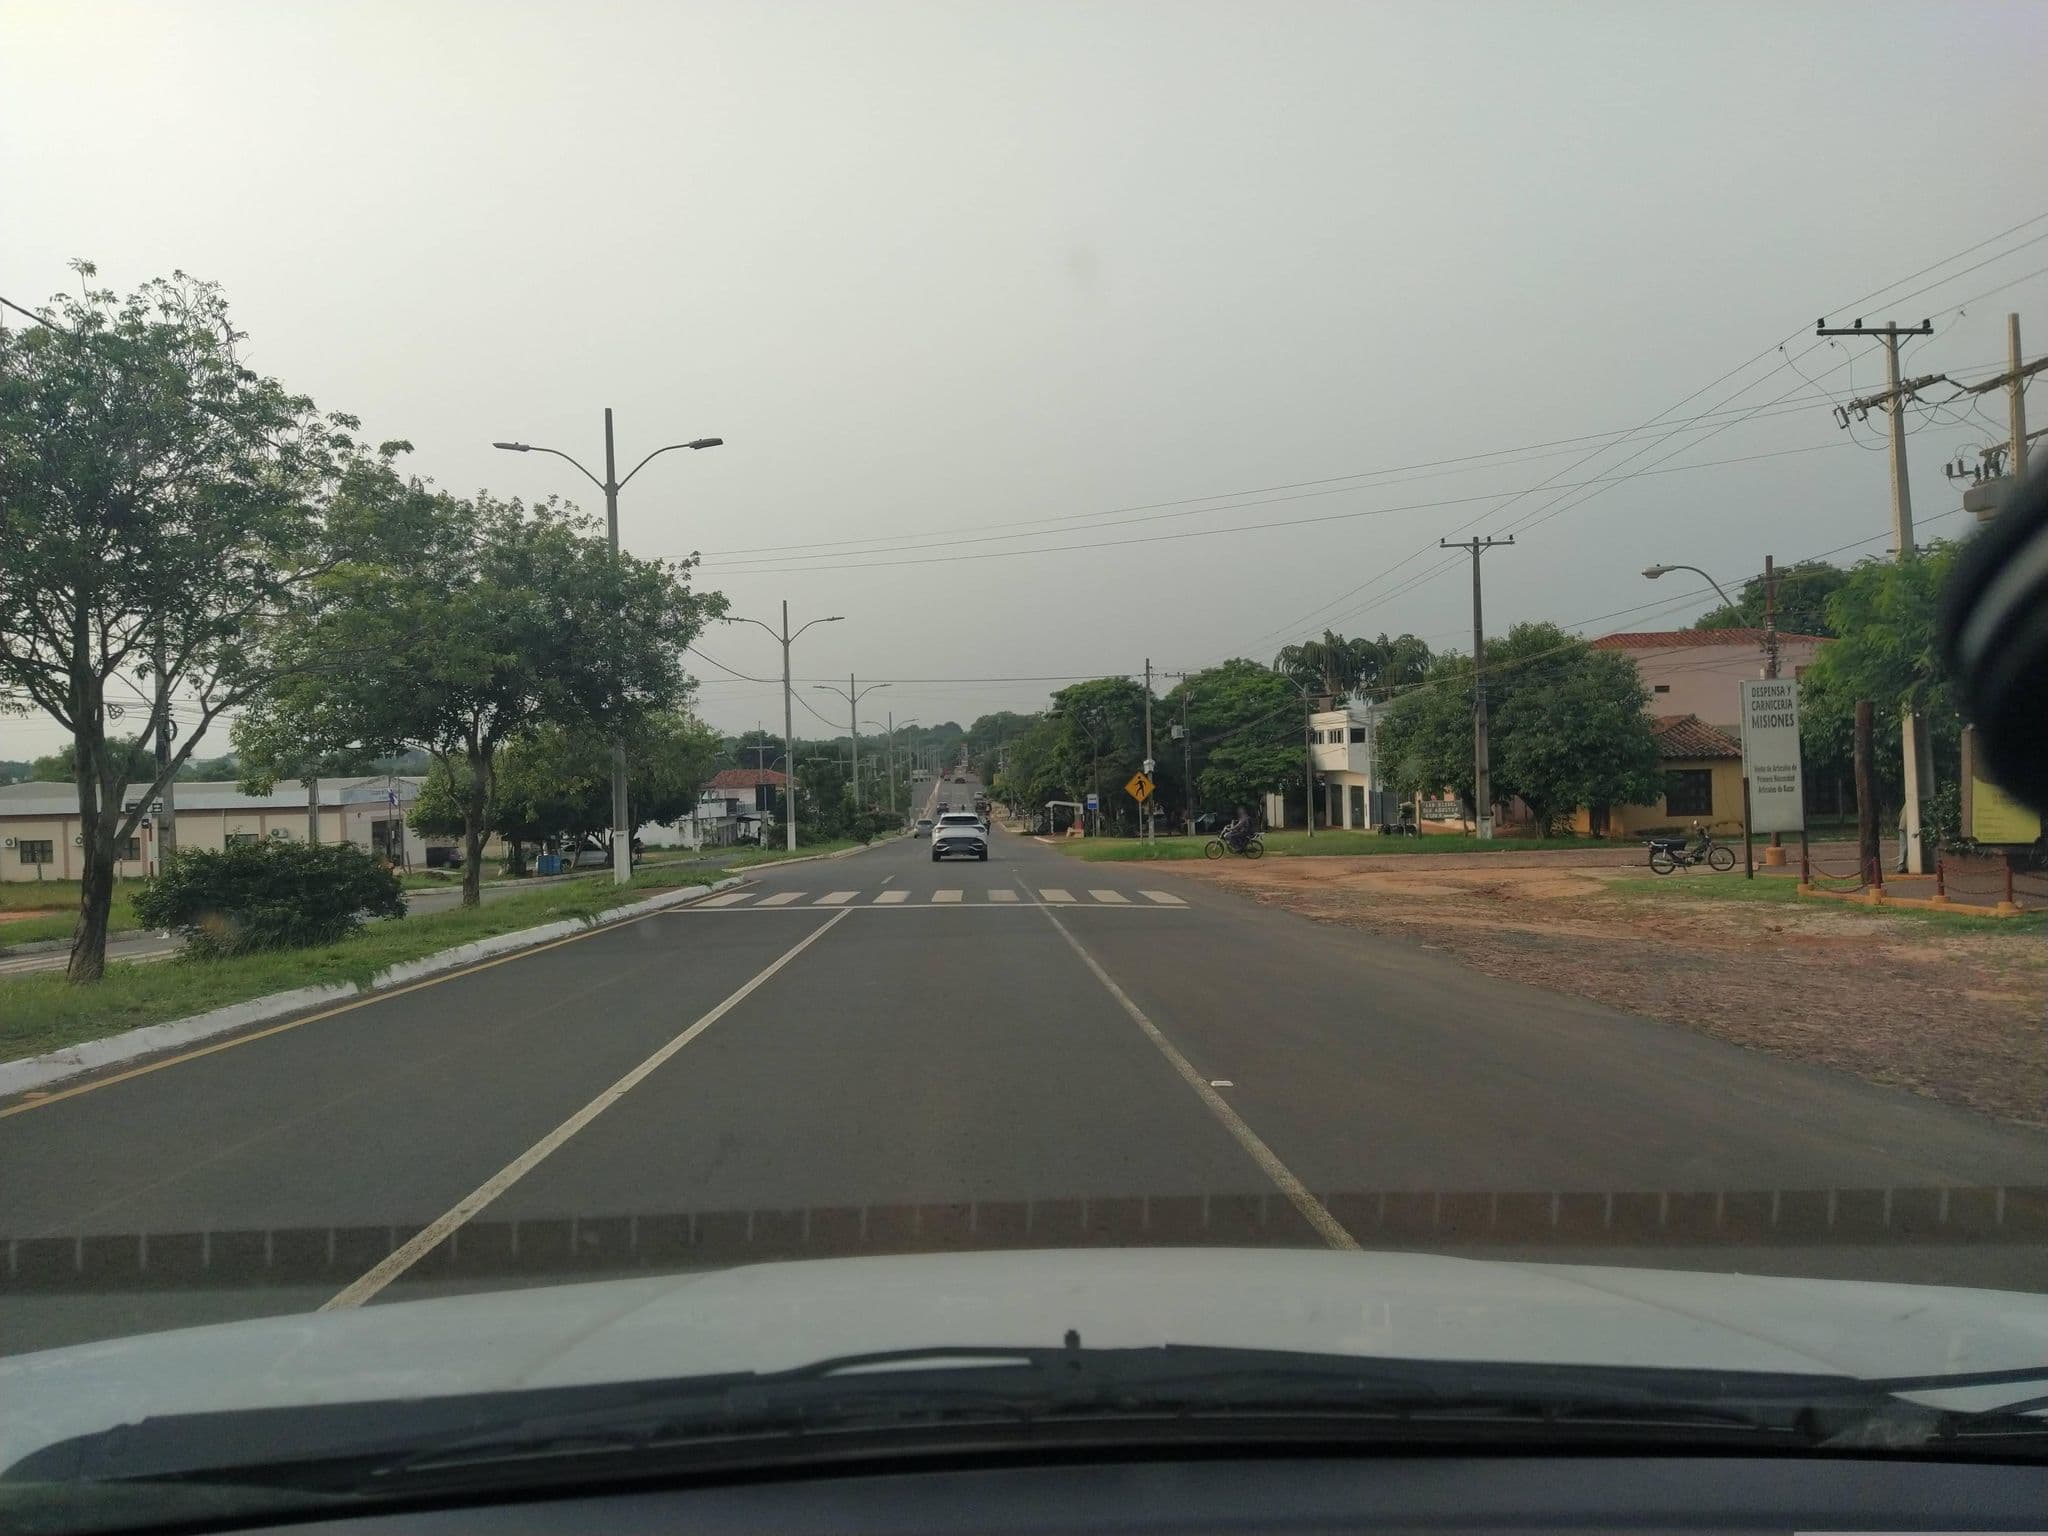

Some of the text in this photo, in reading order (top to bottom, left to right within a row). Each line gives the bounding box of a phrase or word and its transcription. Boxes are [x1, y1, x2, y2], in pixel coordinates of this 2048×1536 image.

[1751, 685, 1792, 698] DESPENSA Y
[1751, 713, 1795, 729] MISIONES
